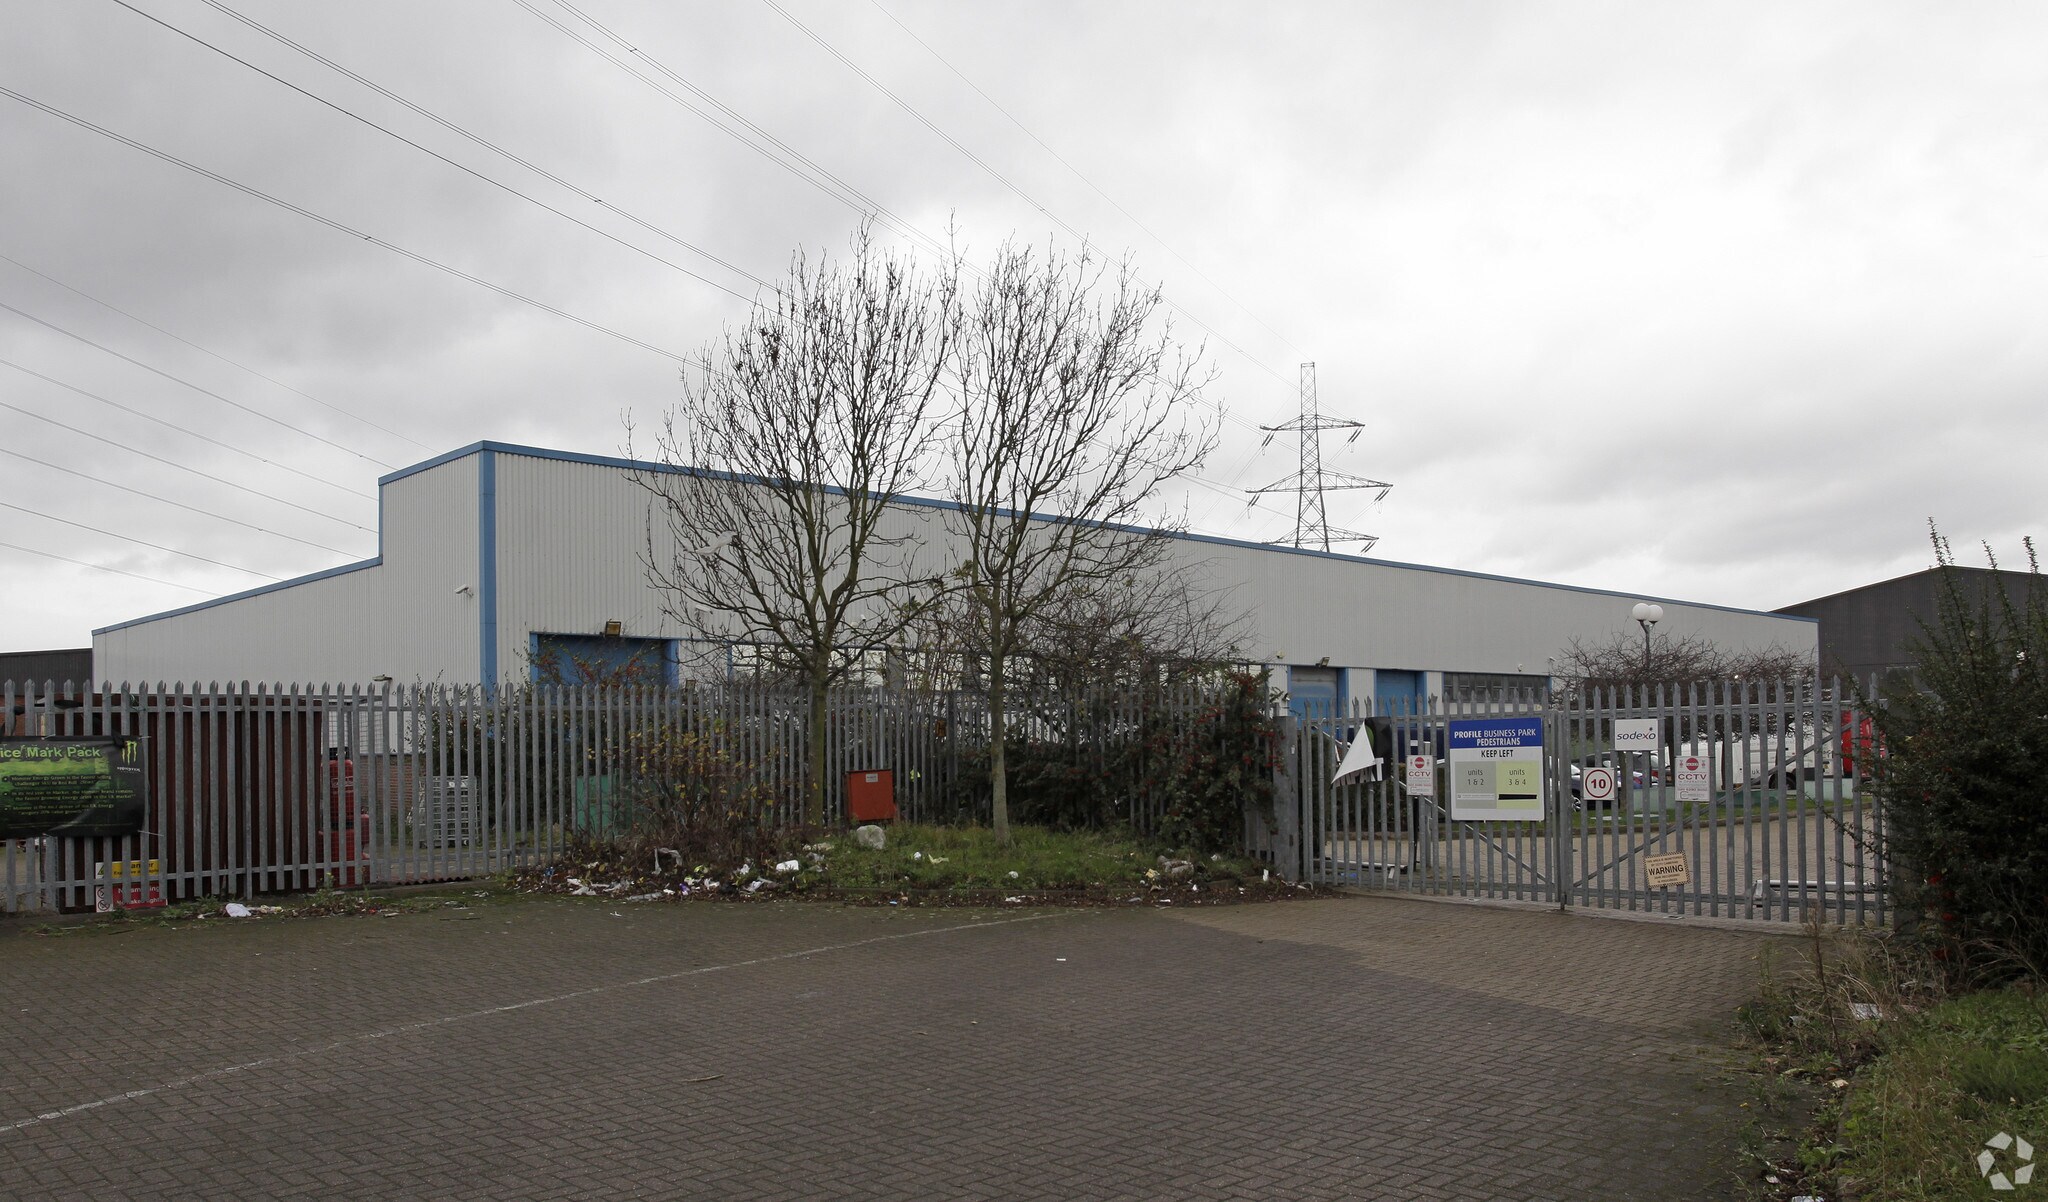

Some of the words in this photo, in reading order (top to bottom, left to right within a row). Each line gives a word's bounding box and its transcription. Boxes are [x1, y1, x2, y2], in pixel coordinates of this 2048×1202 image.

[1454, 731, 1482, 739] PROFILE
[1484, 729, 1516, 738] BUSINESS
[1518, 728, 1537, 737] PARK
[1617, 729, 1656, 740] sodexo
[1476, 737, 1521, 747] PEDESTRIANS
[26, 746, 62, 758] Mark
[67, 746, 101, 757] Pack
[1481, 750, 1498, 758] KEEP
[1499, 749, 1514, 758] LEFT
[1467, 768, 1484, 776] units
[1508, 768, 1526, 776] units
[1467, 778, 1471, 786] 1
[1480, 778, 1485, 786] 2
[1508, 778, 1513, 786] 3
[1522, 778, 1527, 786] 4
[1590, 778, 1607, 789] 10
[1648, 864, 1684, 876] WARNING
